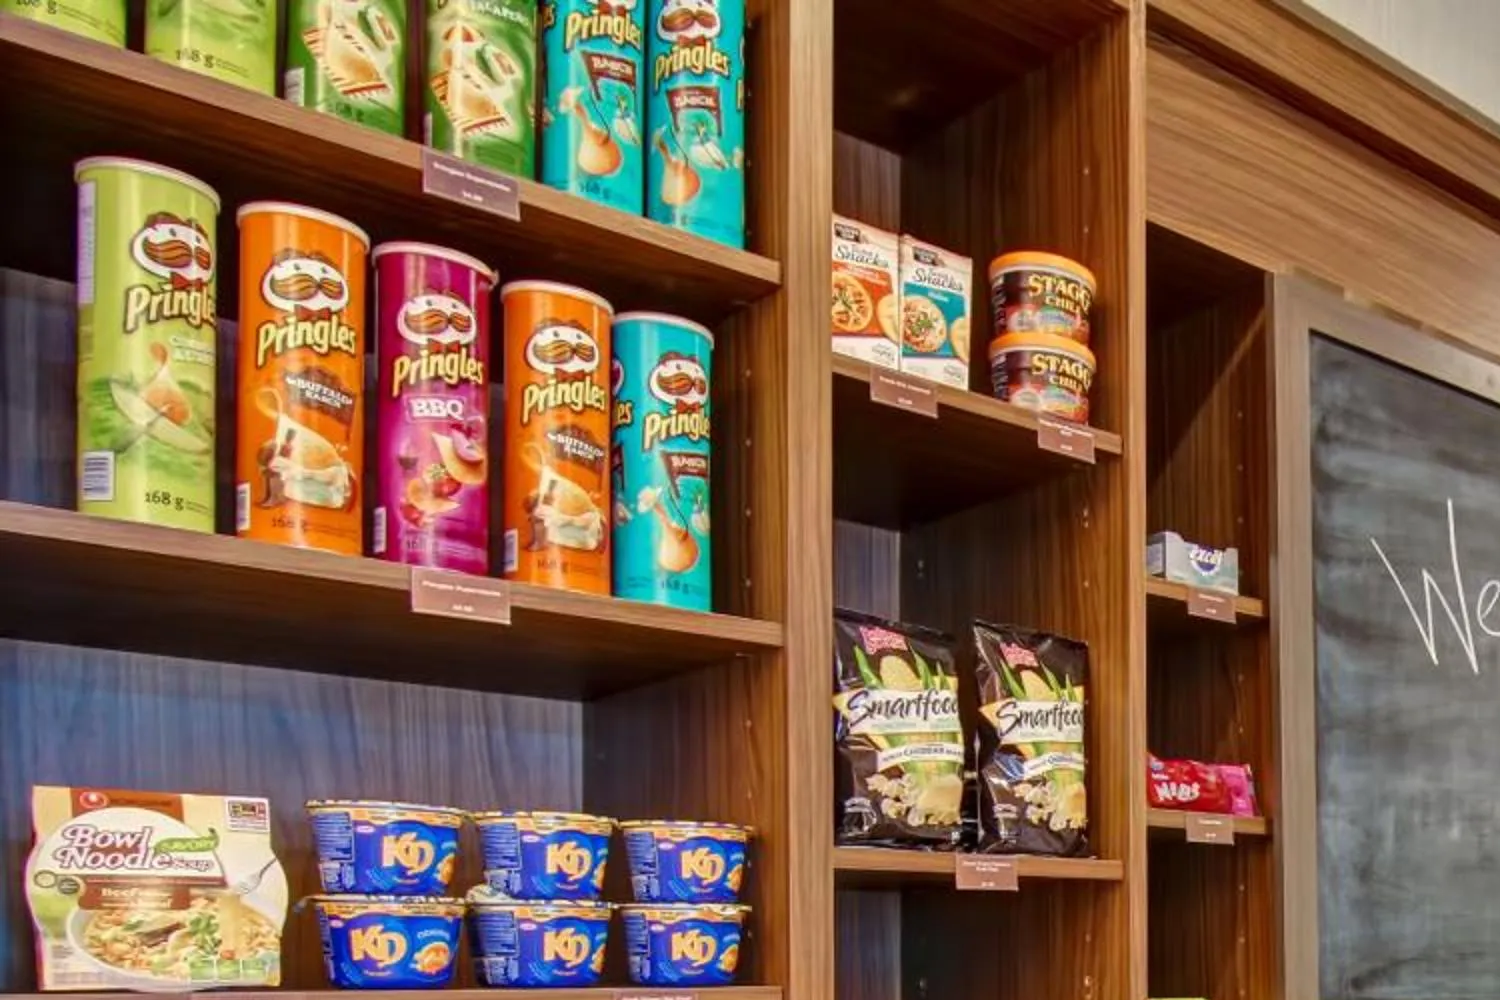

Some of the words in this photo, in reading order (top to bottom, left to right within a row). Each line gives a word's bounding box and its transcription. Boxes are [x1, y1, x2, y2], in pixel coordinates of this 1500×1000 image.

[654, 43, 730, 92] Pringles
[124, 284, 217, 332] Pringle
[1028, 274, 1093, 311] STAGG
[256, 312, 357, 368] Pringles
[392, 349, 484, 398] Pringles
[409, 398, 465, 420] BBQ
[521, 376, 606, 425] Pringles
[643, 409, 711, 451] Pringle
[144, 491, 171, 507] 168
[62, 824, 153, 851] Bowl
[52, 847, 173, 872] Noodle
